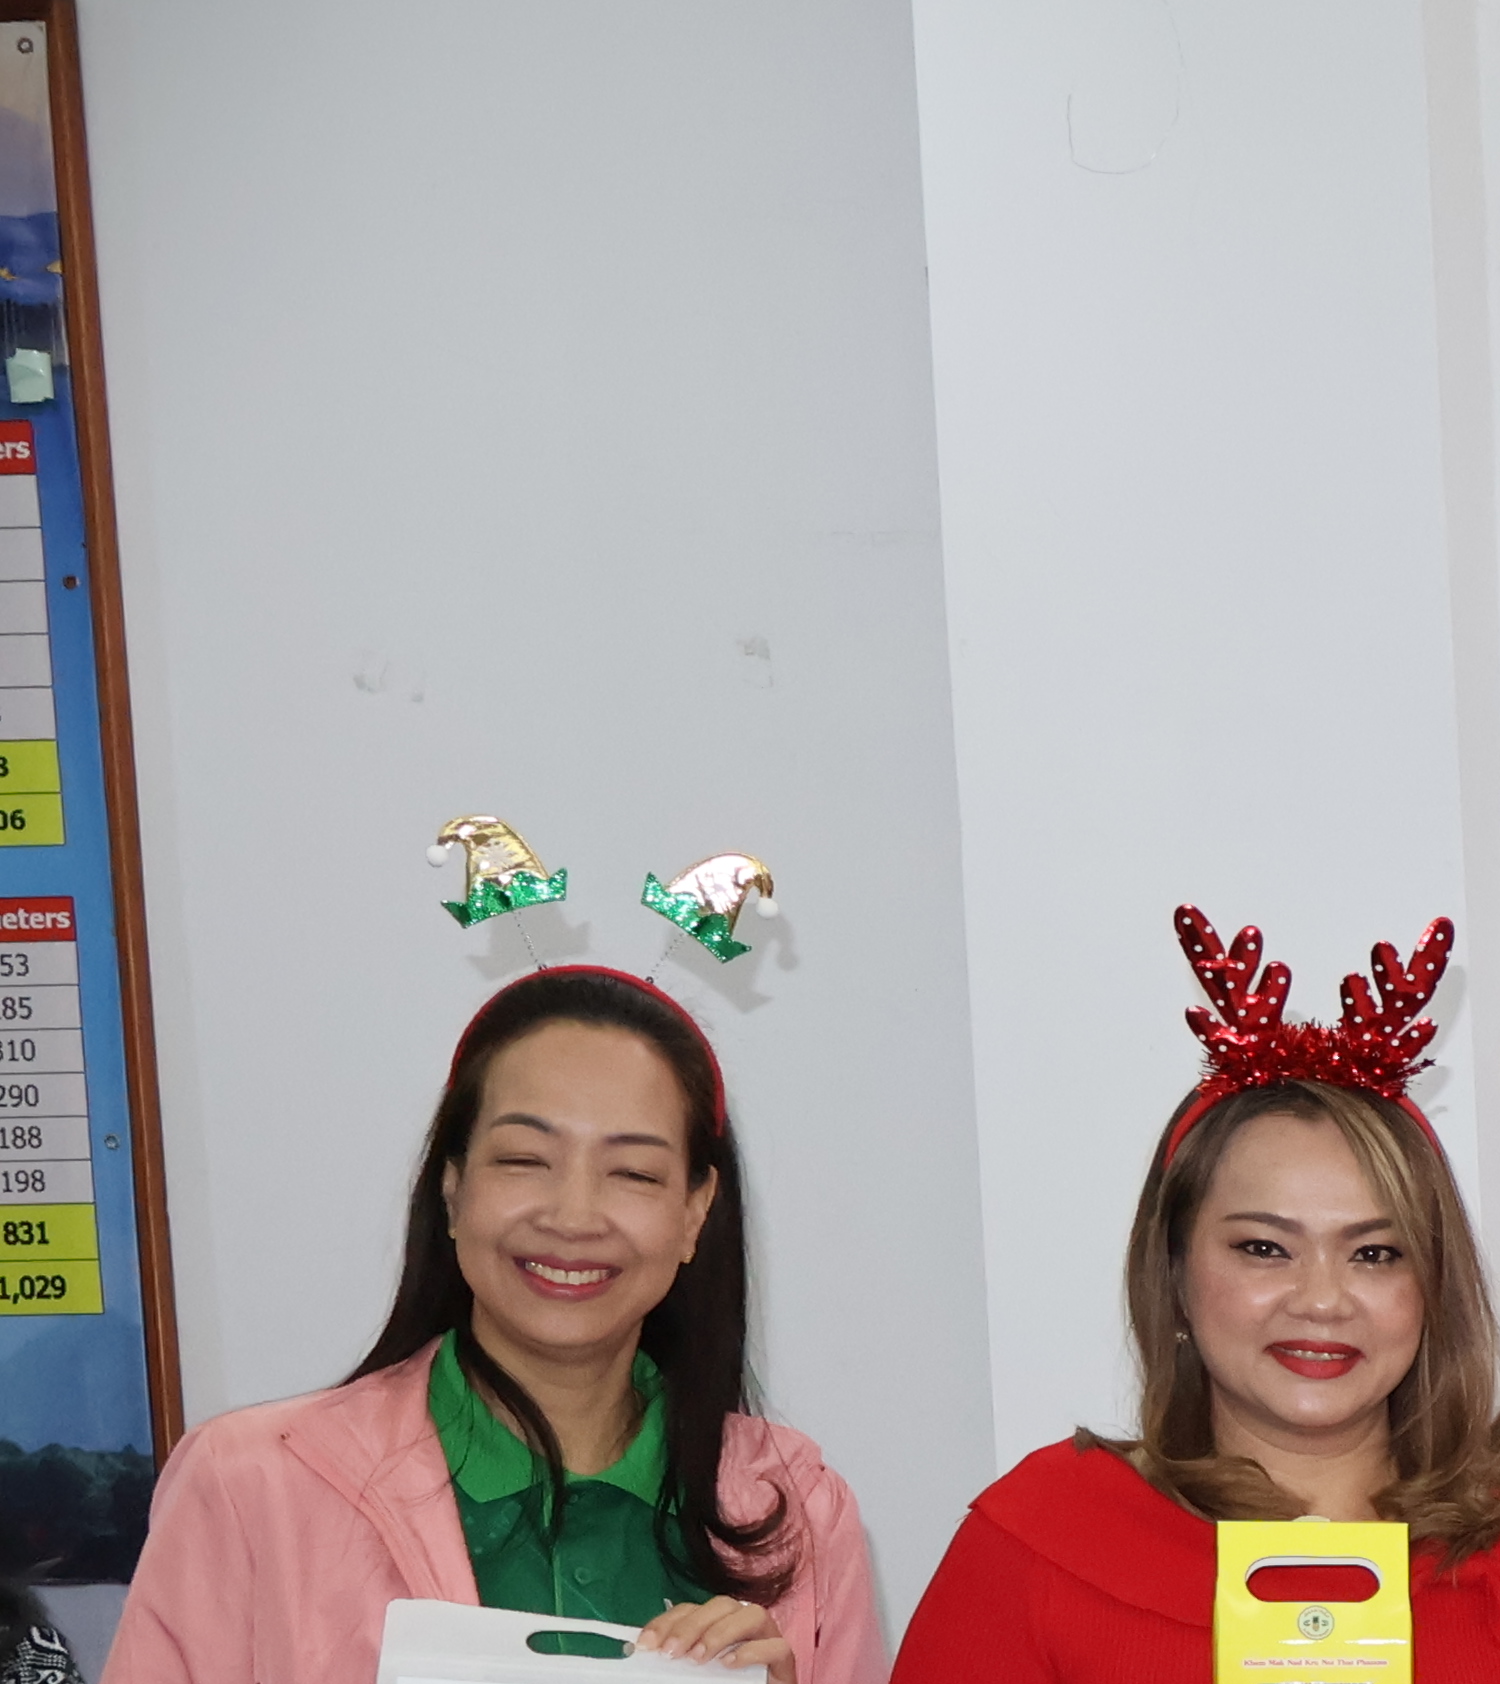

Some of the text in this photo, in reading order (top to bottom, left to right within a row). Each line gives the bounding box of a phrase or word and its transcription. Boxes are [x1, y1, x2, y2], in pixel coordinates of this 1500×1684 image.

[0, 441, 31, 460] ers
[2, 1170, 46, 1193] 198
[3, 1221, 50, 1246] 831
